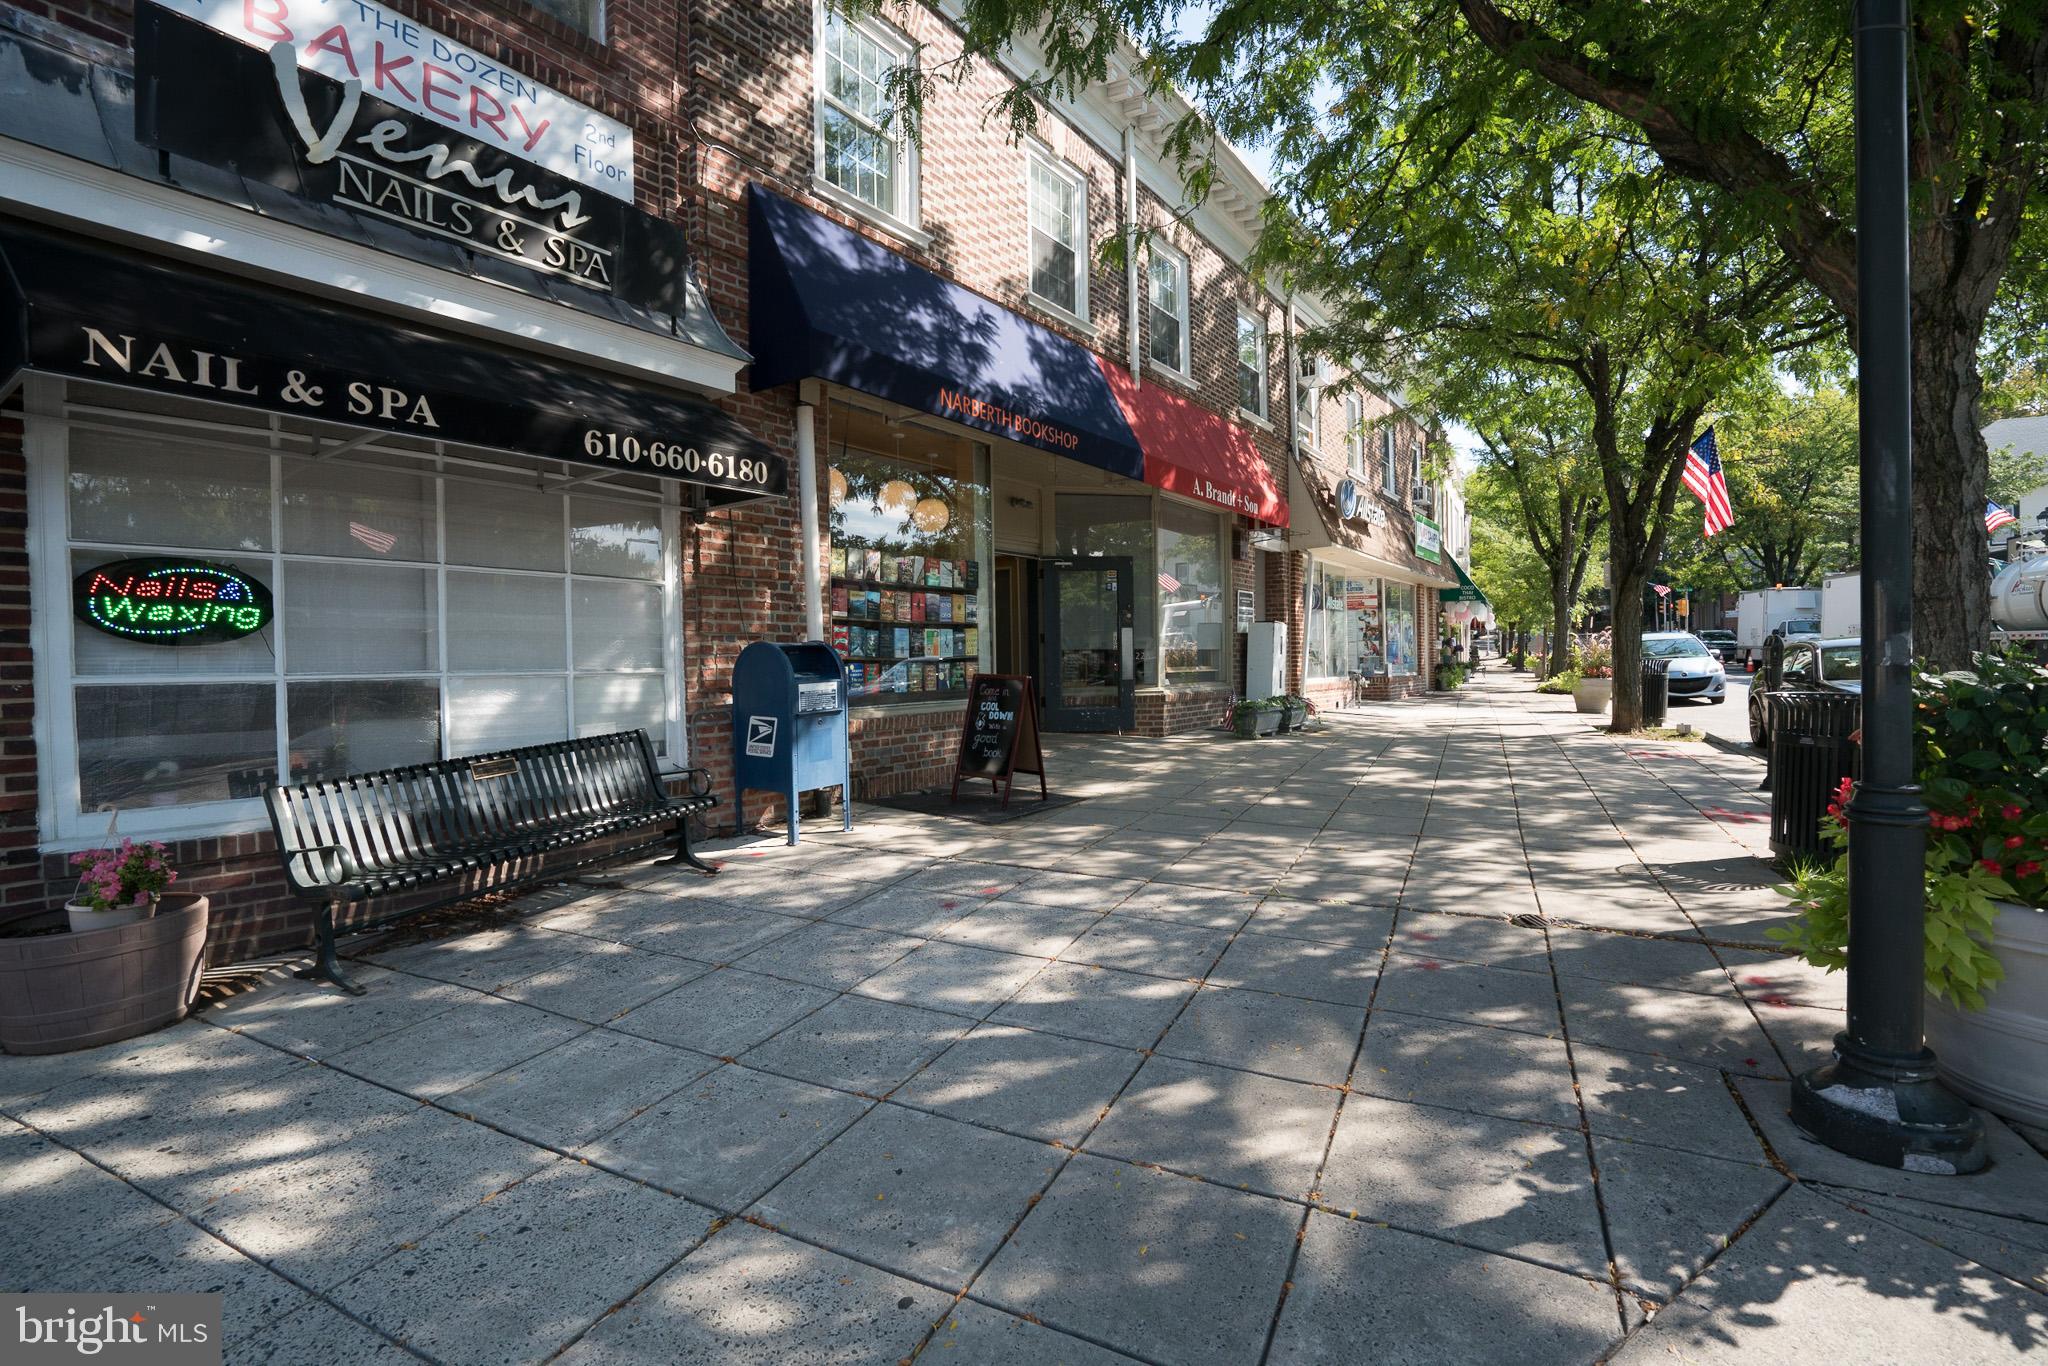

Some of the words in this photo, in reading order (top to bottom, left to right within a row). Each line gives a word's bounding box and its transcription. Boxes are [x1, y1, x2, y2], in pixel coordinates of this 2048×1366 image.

[350, 0, 420, 50] THE
[432, 38, 538, 105] DOZEN
[243, 0, 551, 153] BAKERY
[268, 40, 593, 228] Venus
[584, 122, 616, 150] 2nd
[573, 143, 628, 183] Floor
[337, 160, 474, 236] NAILS
[496, 219, 525, 256] &
[543, 235, 611, 284] SPA
[80, 326, 259, 396] NAIL
[280, 369, 325, 408] &
[347, 381, 441, 429] SPA
[939, 386, 1013, 430] NARBERTH
[1014, 413, 1080, 451] BOOKSHOP
[1192, 477, 1204, 497] A.
[1205, 480, 1237, 508] Brandt
[1244, 494, 1259, 515] Son
[89, 573, 217, 600] Nails
[103, 596, 262, 630] Waxing
[980, 702, 1000, 711] COOL
[988, 711, 1014, 721] DOWN
[971, 732, 998, 749] good
